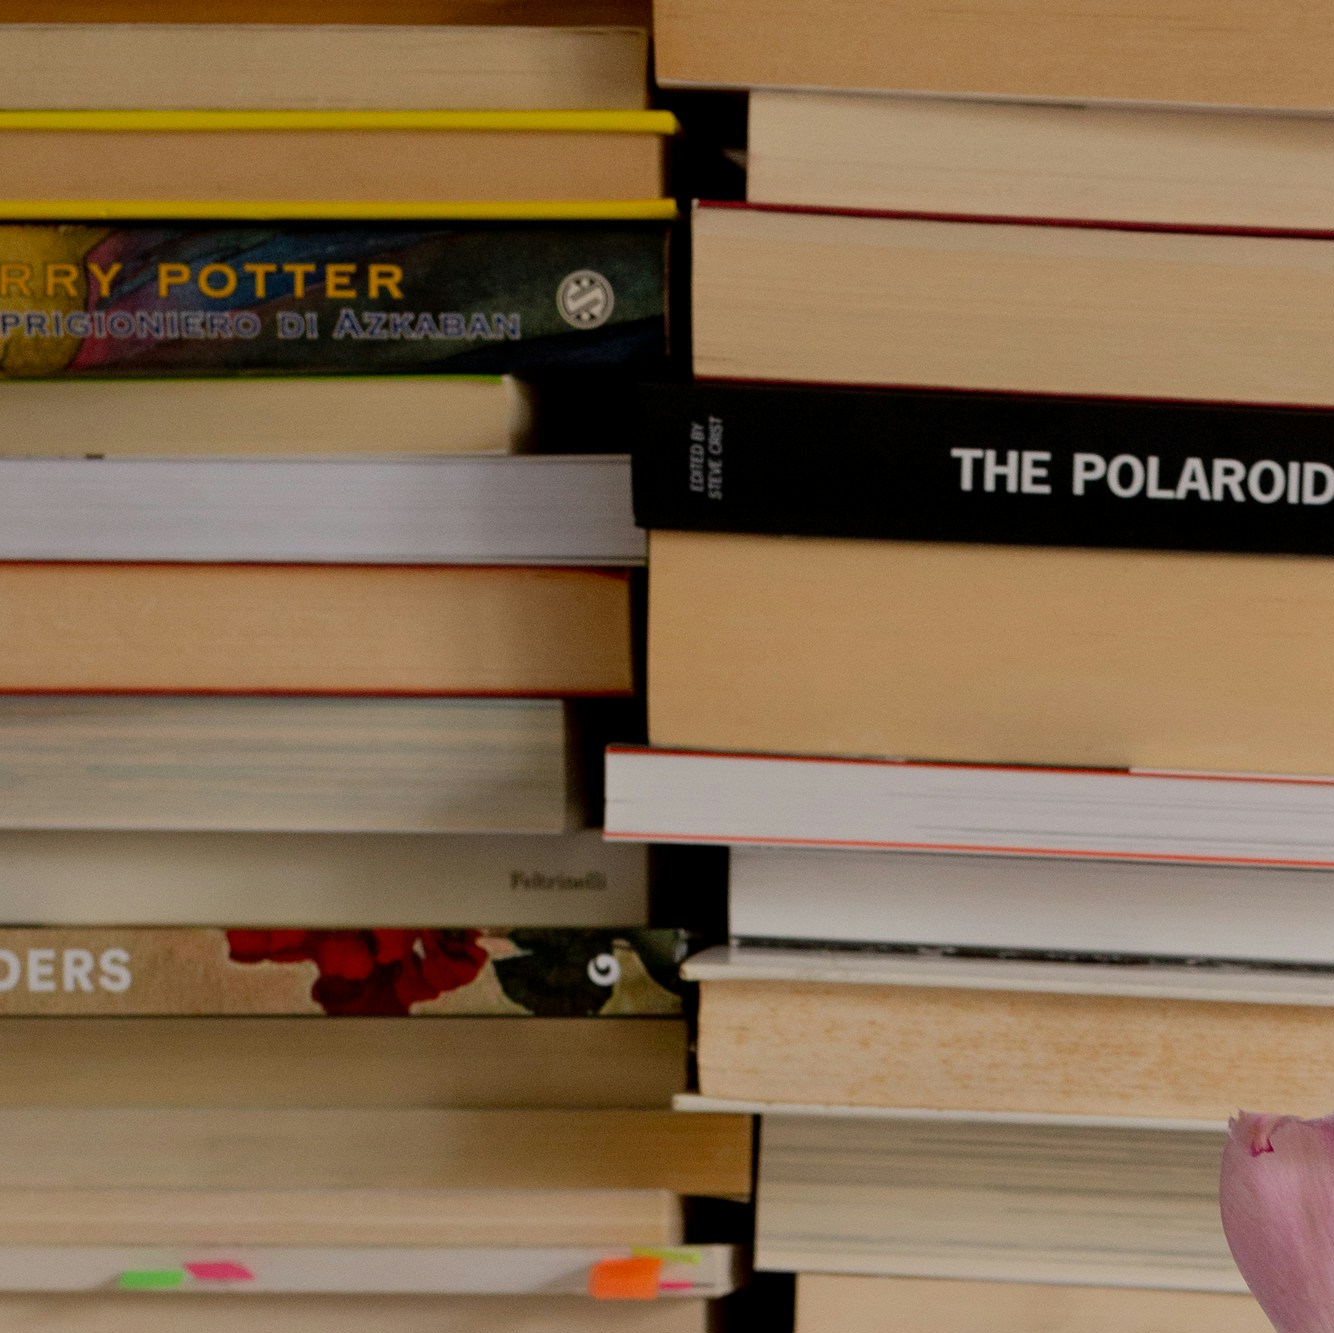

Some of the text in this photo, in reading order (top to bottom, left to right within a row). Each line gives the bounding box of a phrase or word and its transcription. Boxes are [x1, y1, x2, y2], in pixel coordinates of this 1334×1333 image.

[157, 262, 405, 300] POTTER
[0, 308, 261, 340] PRIGIONIERO
[276, 310, 320, 340] DI
[688, 421, 705, 493] EDITED BY
[949, 446, 1053, 497] THE
[706, 458, 723, 501] STEVE
